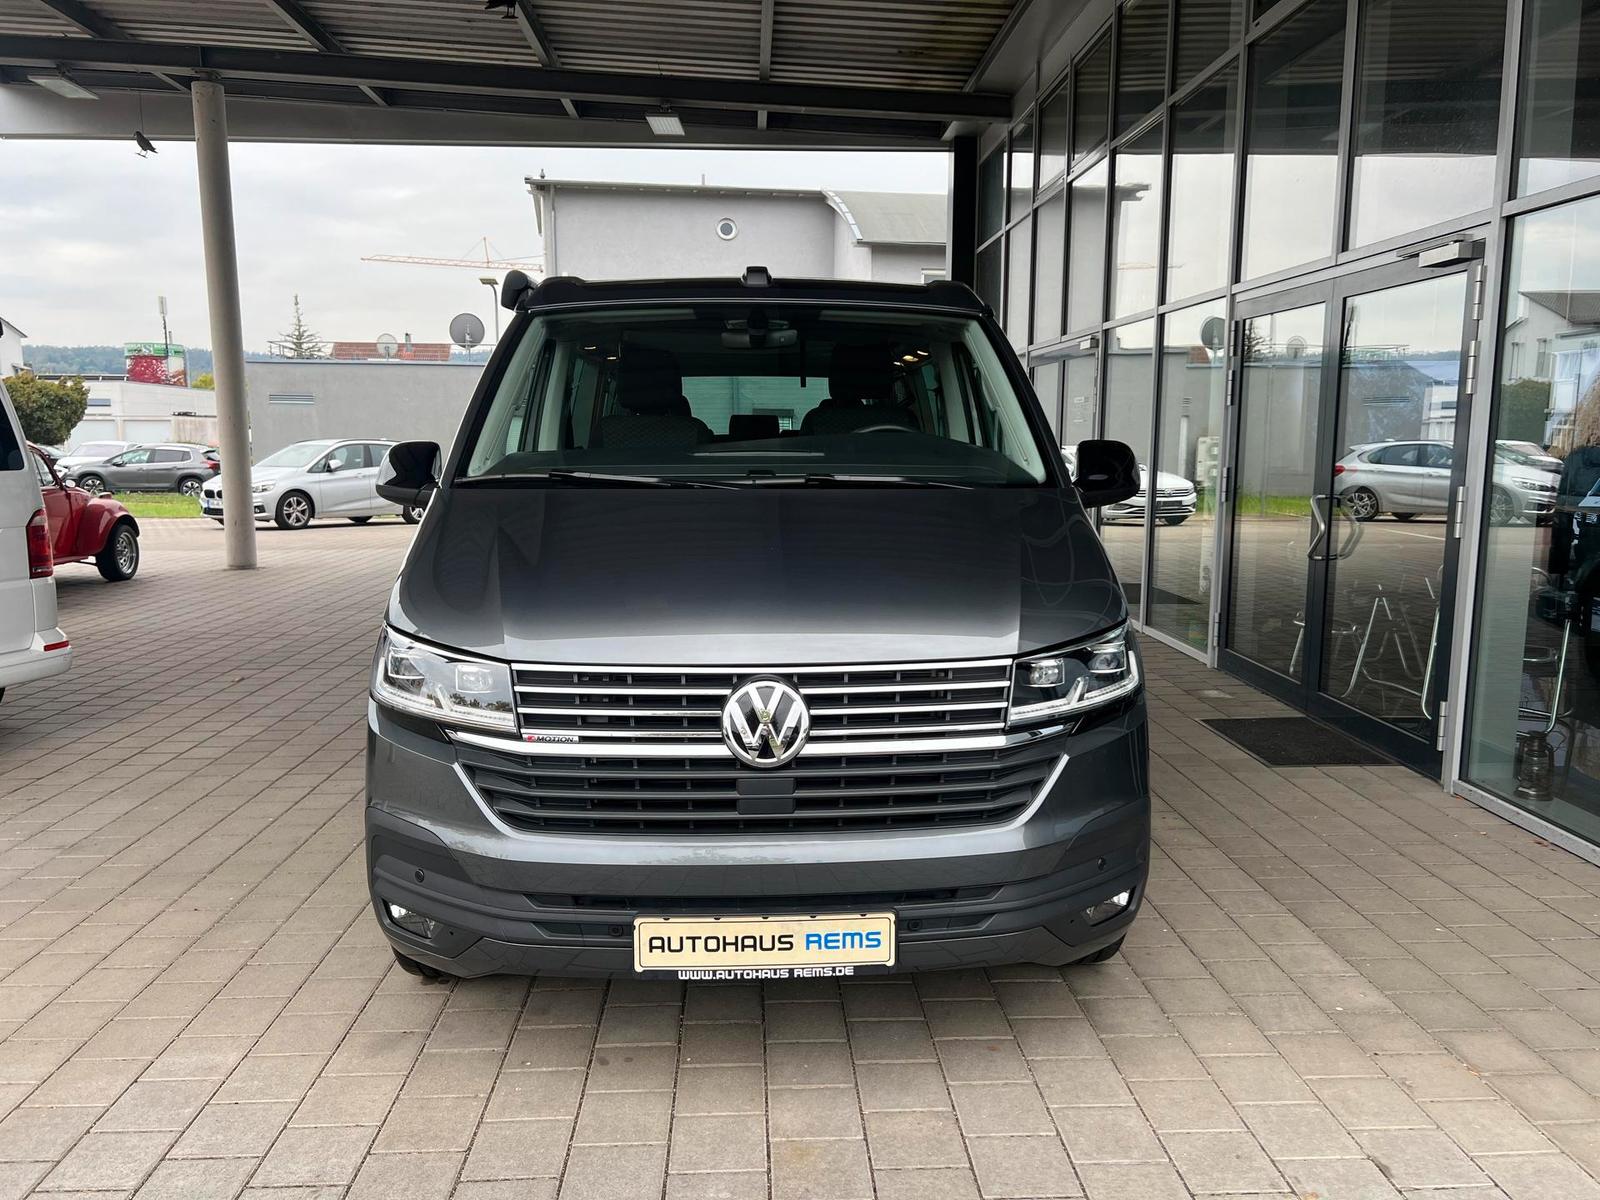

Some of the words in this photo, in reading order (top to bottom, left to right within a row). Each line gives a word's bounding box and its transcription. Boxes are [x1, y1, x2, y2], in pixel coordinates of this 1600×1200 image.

[722, 680, 809, 768] VW
[649, 934, 794, 953] AUTOHAUS
[805, 931, 881, 950] REMS
[793, 967, 855, 977] REMS.DE
